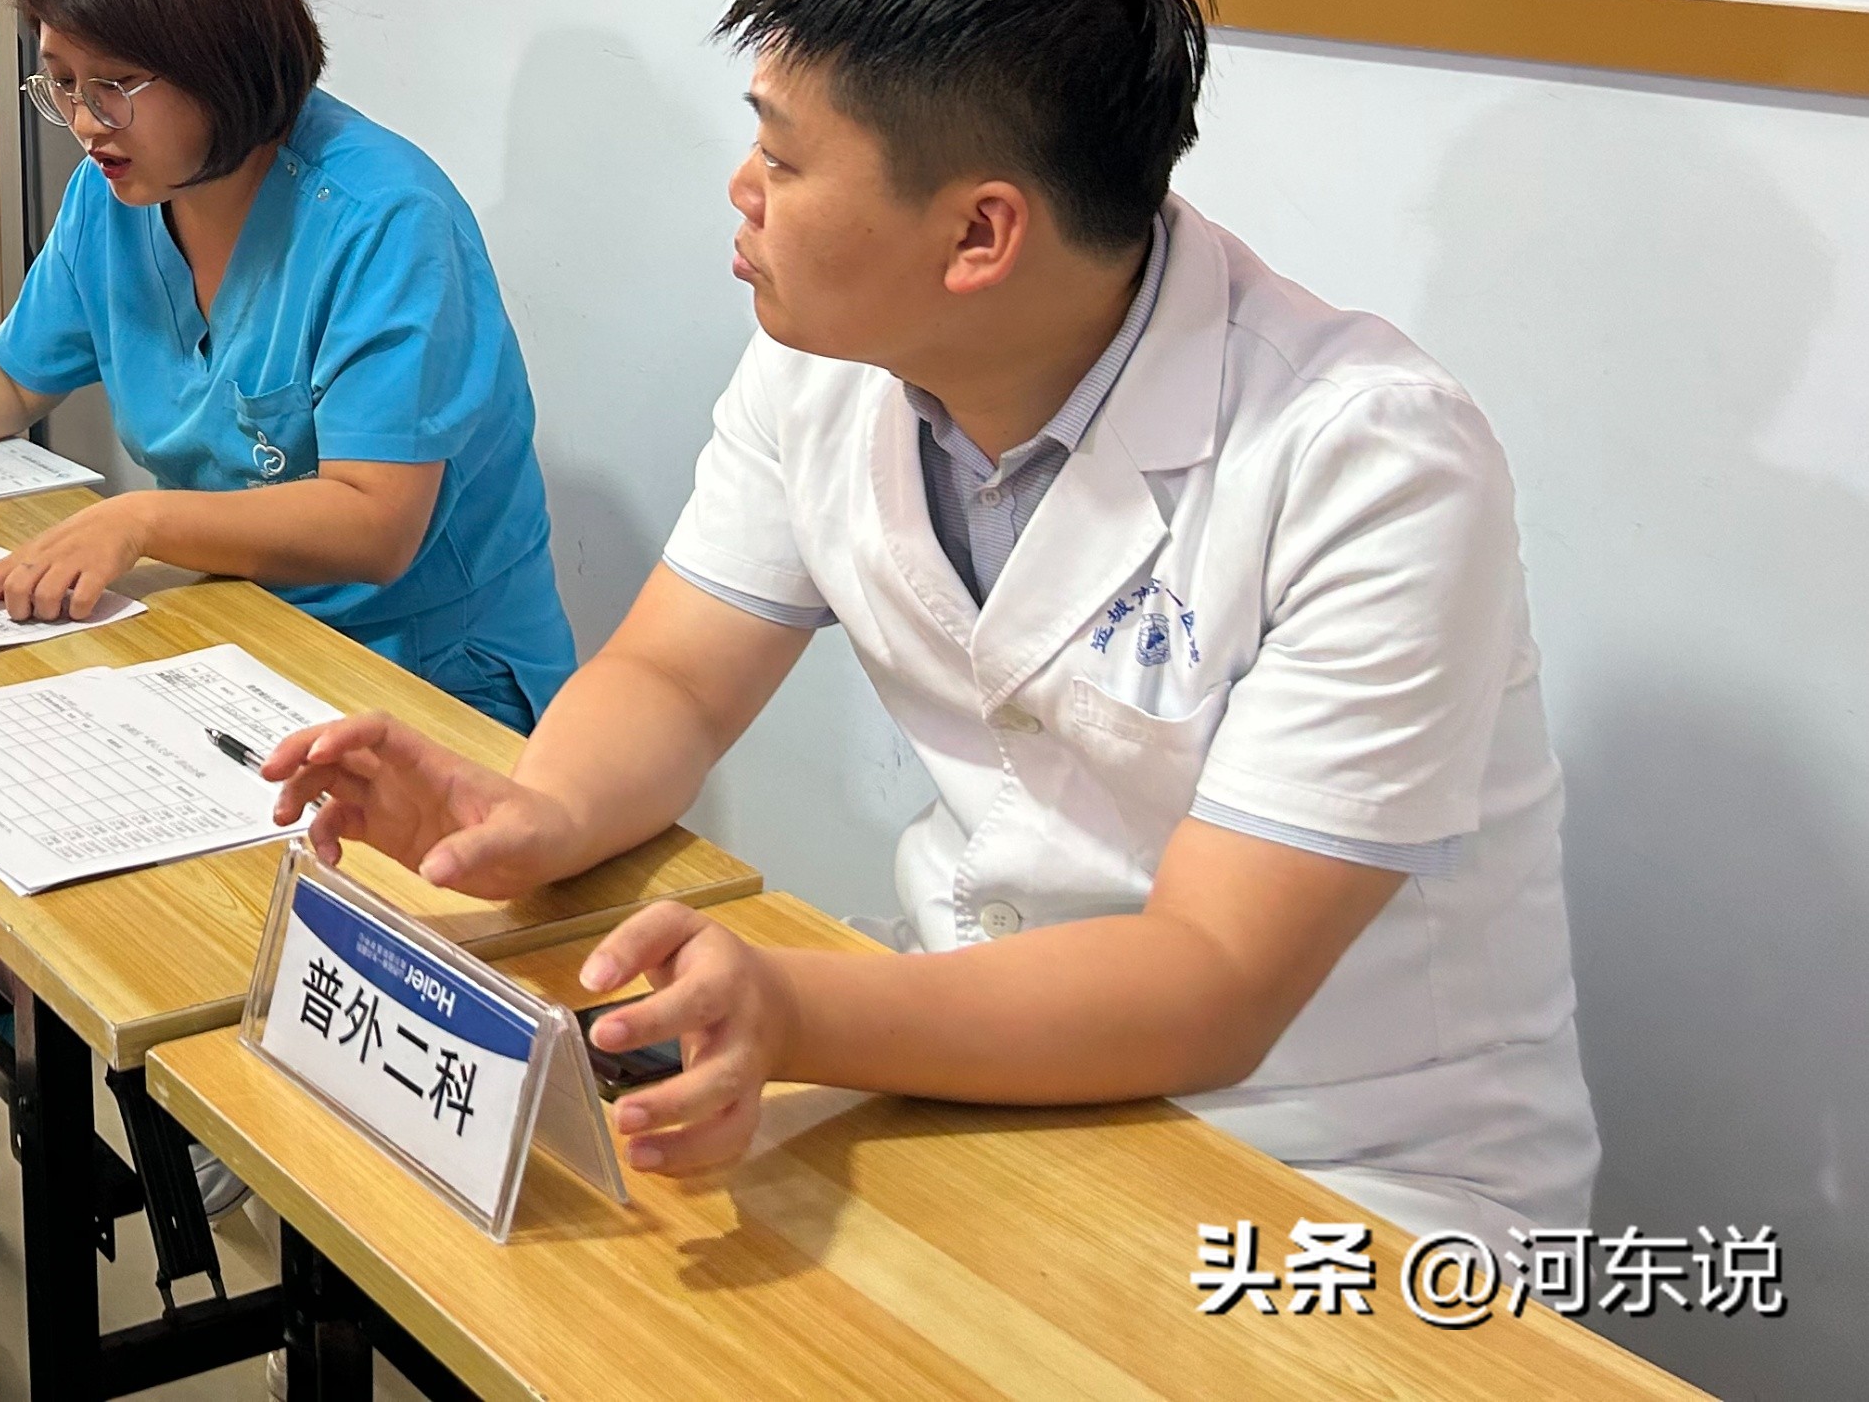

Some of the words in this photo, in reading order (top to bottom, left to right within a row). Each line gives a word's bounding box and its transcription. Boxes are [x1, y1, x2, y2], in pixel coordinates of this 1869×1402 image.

[404, 955, 456, 1017] Haier
[298, 957, 478, 1137] 普外二科
